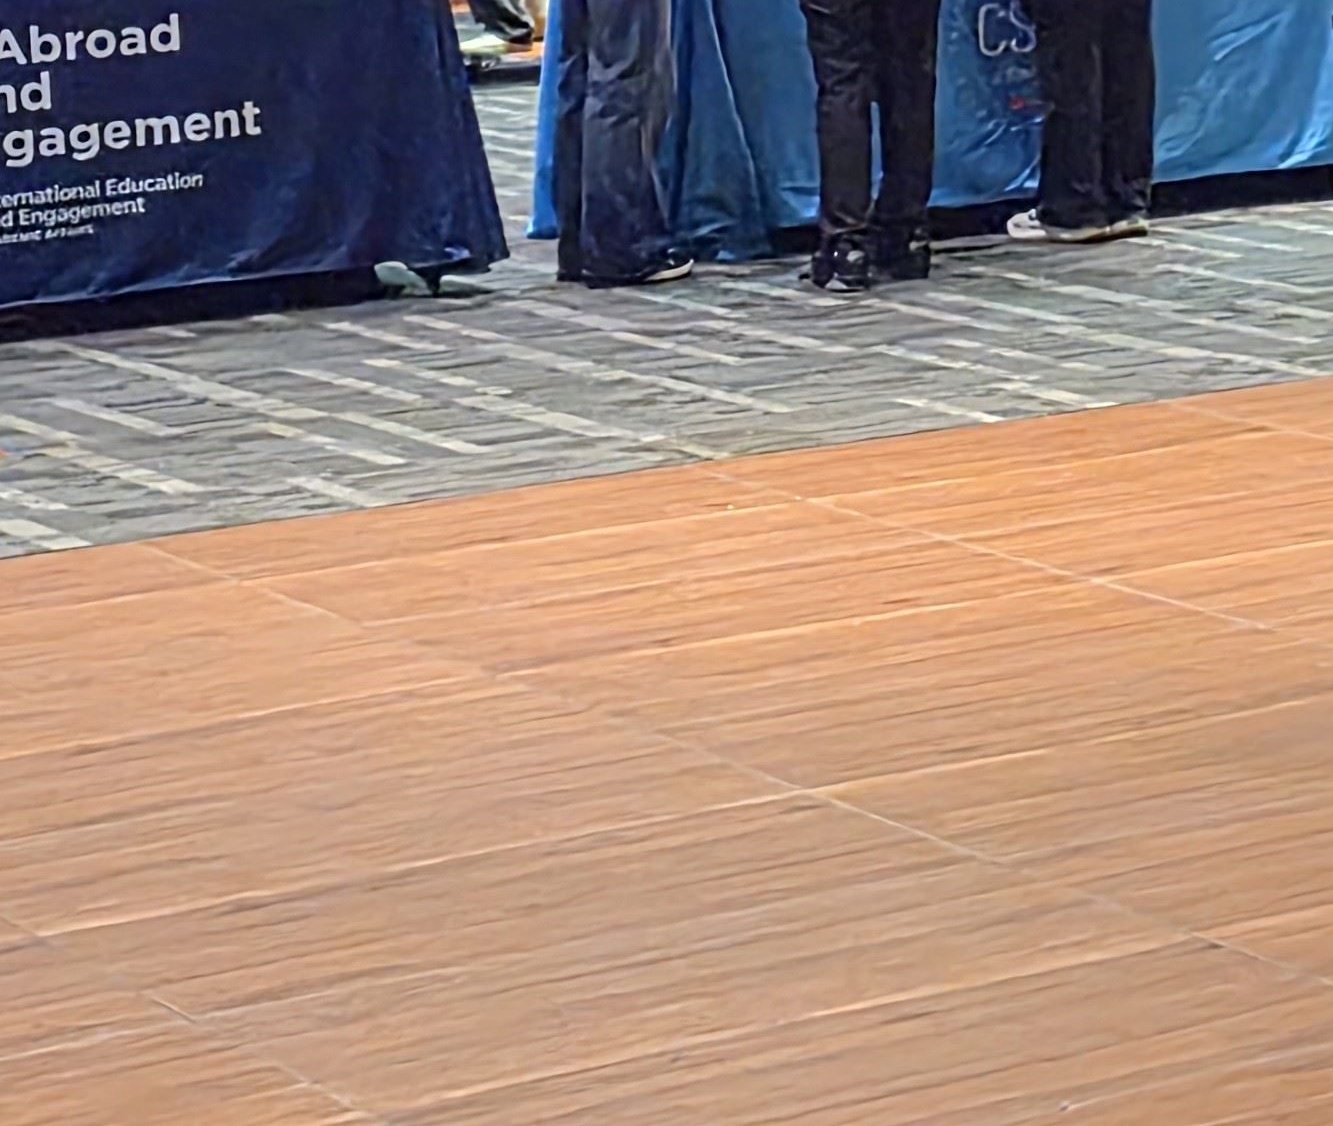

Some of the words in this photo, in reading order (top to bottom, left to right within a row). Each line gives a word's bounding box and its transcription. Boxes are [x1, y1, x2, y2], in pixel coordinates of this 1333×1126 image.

[0, 13, 181, 65] Abroad
[0, 71, 51, 114] nd
[0, 101, 262, 168] gagement
[105, 172, 204, 197] Education
[18, 197, 147, 227] Engagement
